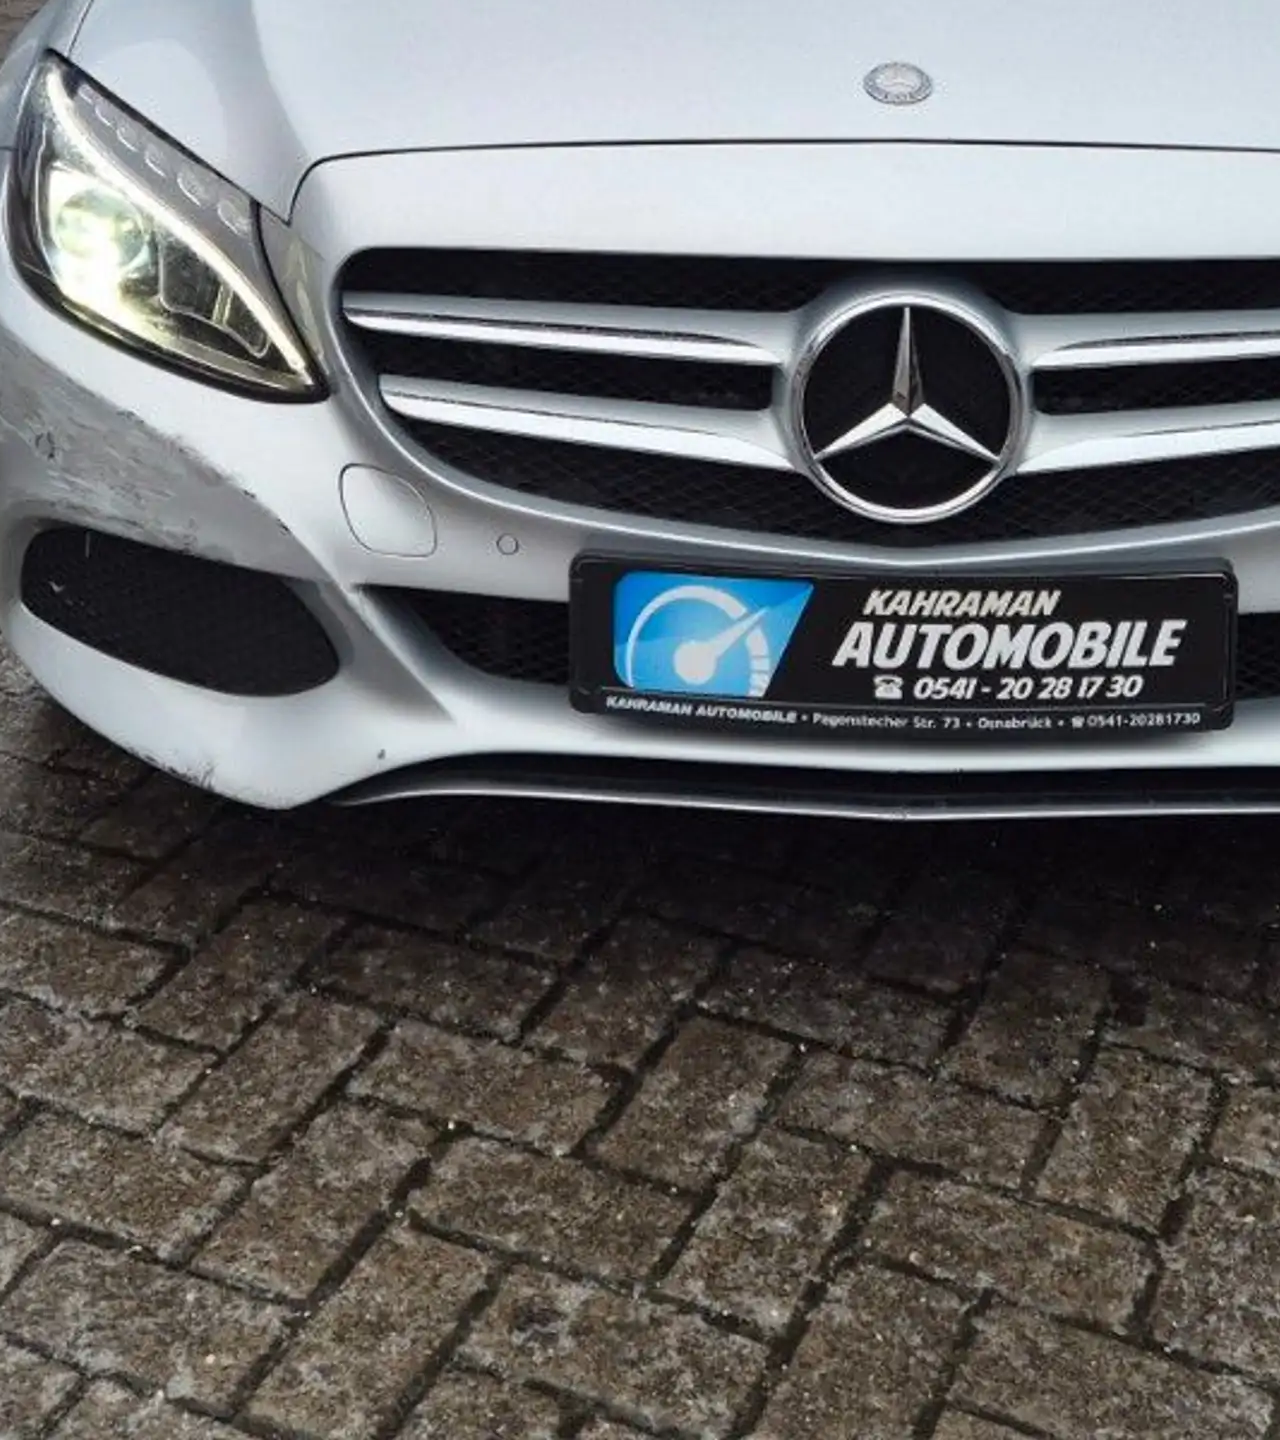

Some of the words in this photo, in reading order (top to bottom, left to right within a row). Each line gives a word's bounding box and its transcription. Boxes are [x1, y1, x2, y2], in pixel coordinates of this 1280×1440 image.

[863, 589, 1062, 617] KAHRAMAN
[831, 619, 1188, 670] AUTOMOBILE
[913, 676, 977, 700] 0541
[996, 677, 1033, 700] 20
[1037, 677, 1073, 700] 28
[1077, 676, 1105, 699] 17
[1106, 675, 1144, 698] 30
[606, 695, 692, 716] KAHRAMAN
[696, 705, 797, 724] AUTOMOBILE
[913, 716, 937, 729] Str.
[943, 716, 961, 729] 73
[977, 714, 1052, 730] Osnabrück
[1086, 712, 1202, 728] 0541-20281730
